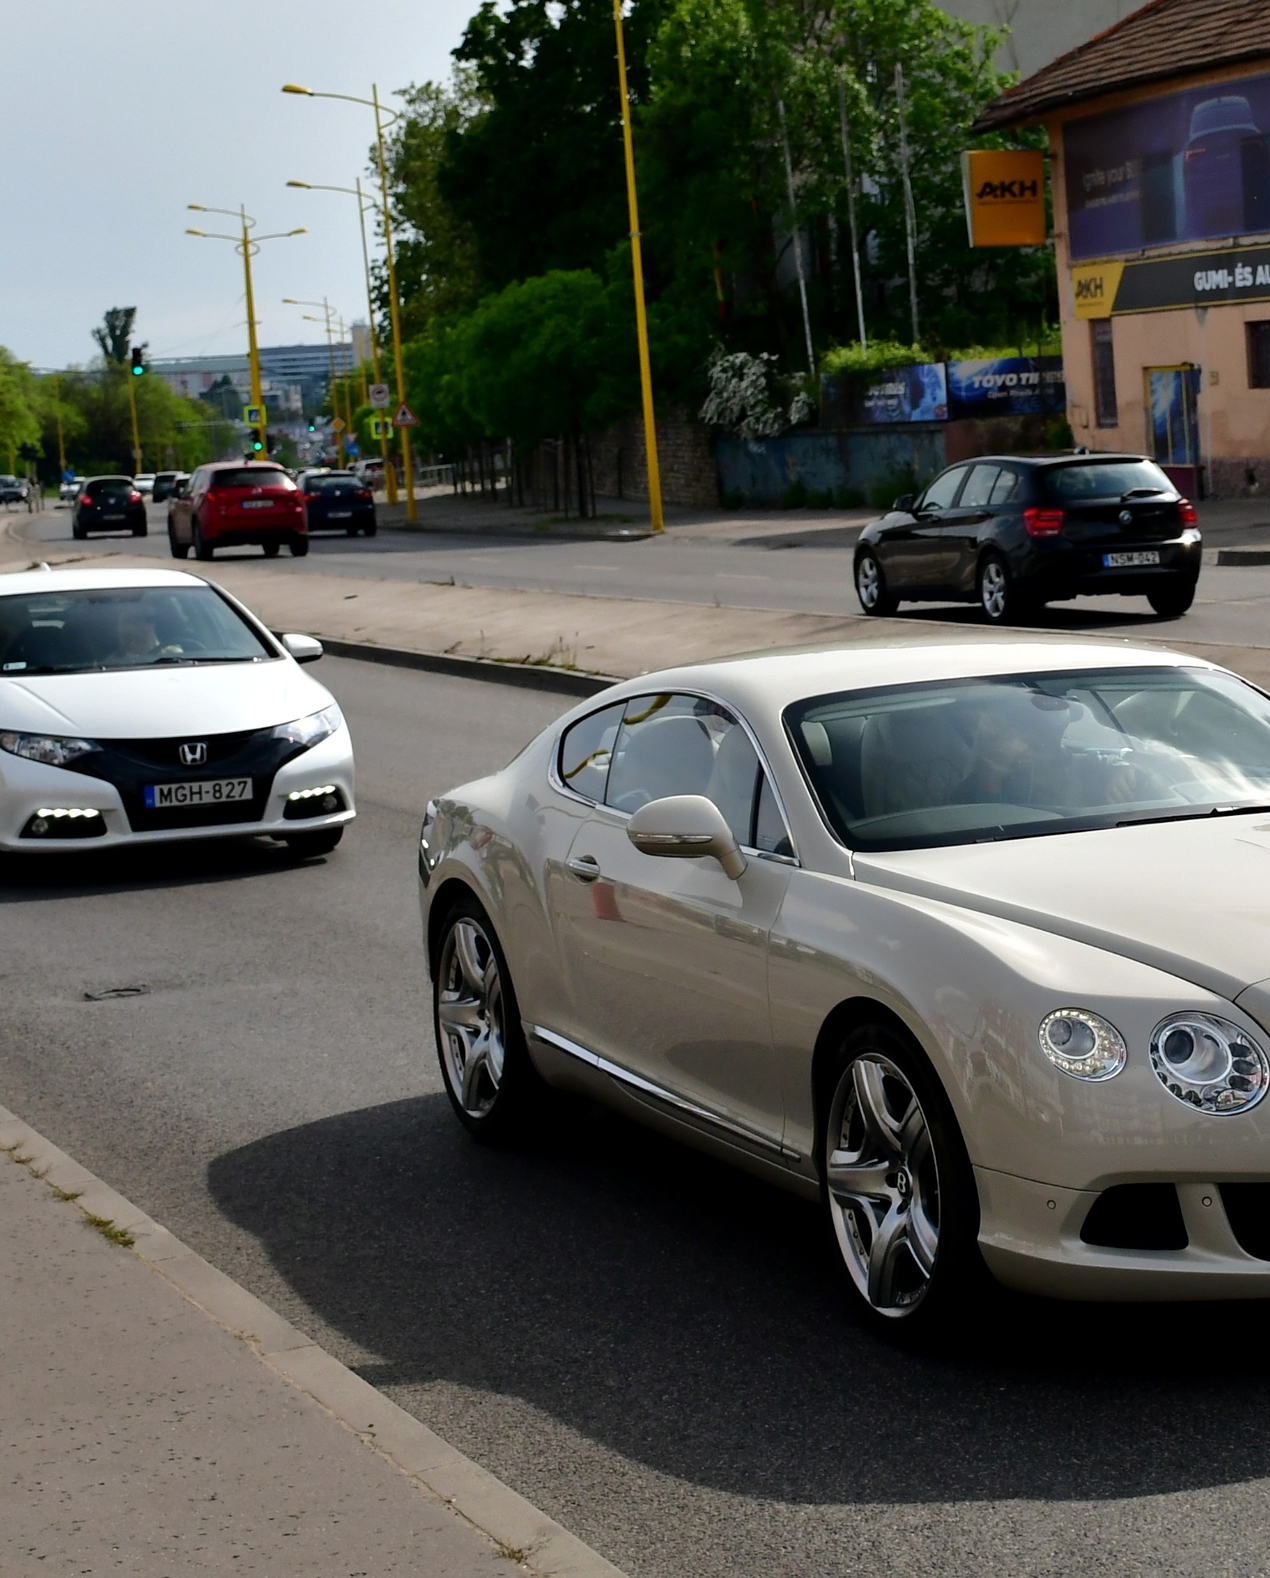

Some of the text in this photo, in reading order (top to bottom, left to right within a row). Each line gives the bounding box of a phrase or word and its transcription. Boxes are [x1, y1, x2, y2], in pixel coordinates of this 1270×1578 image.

[976, 179, 1037, 199] AKH
[1194, 269, 1233, 291] GUMI-
[1235, 262, 1253, 288] ÉS
[973, 373, 1019, 389] TOYO
[160, 780, 248, 804] MGH-827
